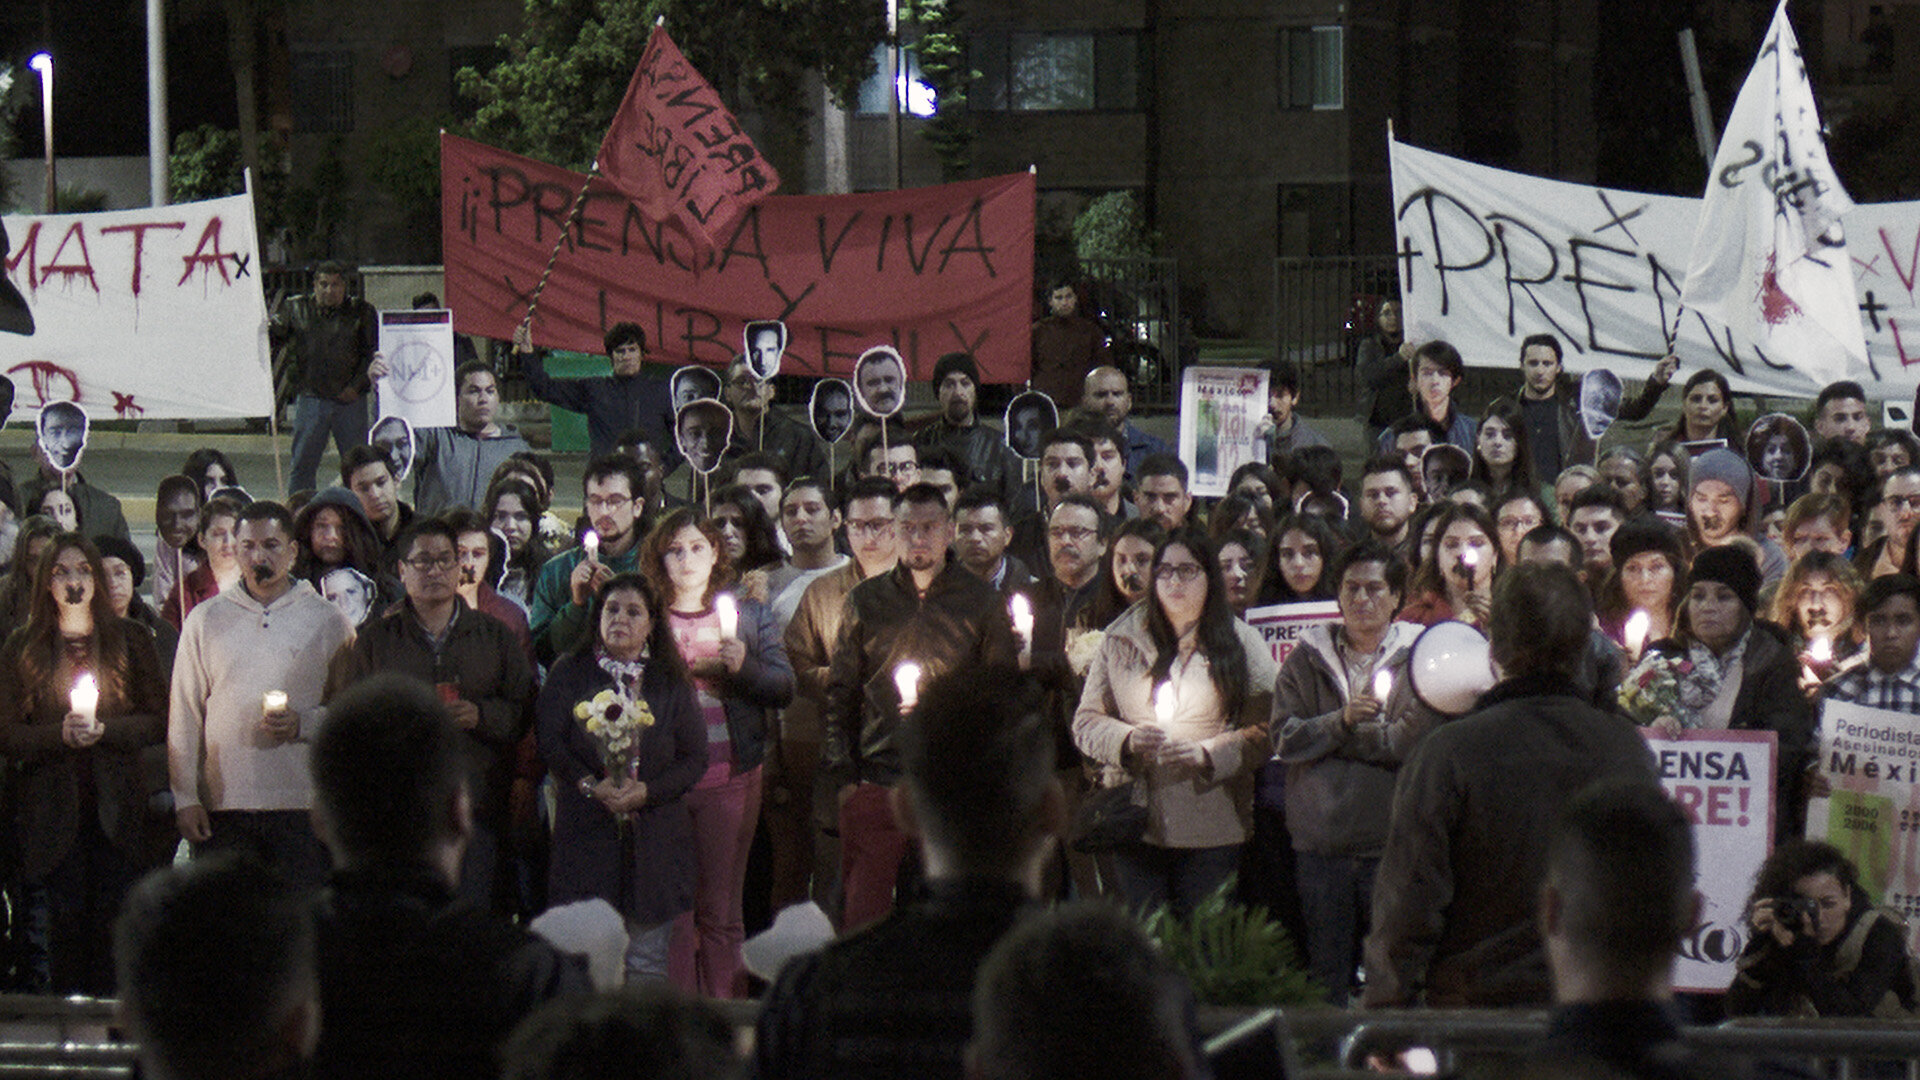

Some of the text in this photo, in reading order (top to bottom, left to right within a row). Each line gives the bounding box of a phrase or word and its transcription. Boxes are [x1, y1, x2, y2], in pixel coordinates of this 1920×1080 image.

[817, 199, 997, 277] VIVA
[1832, 736, 1920, 758] Asesinado
[1663, 785, 1750, 828] RE!
